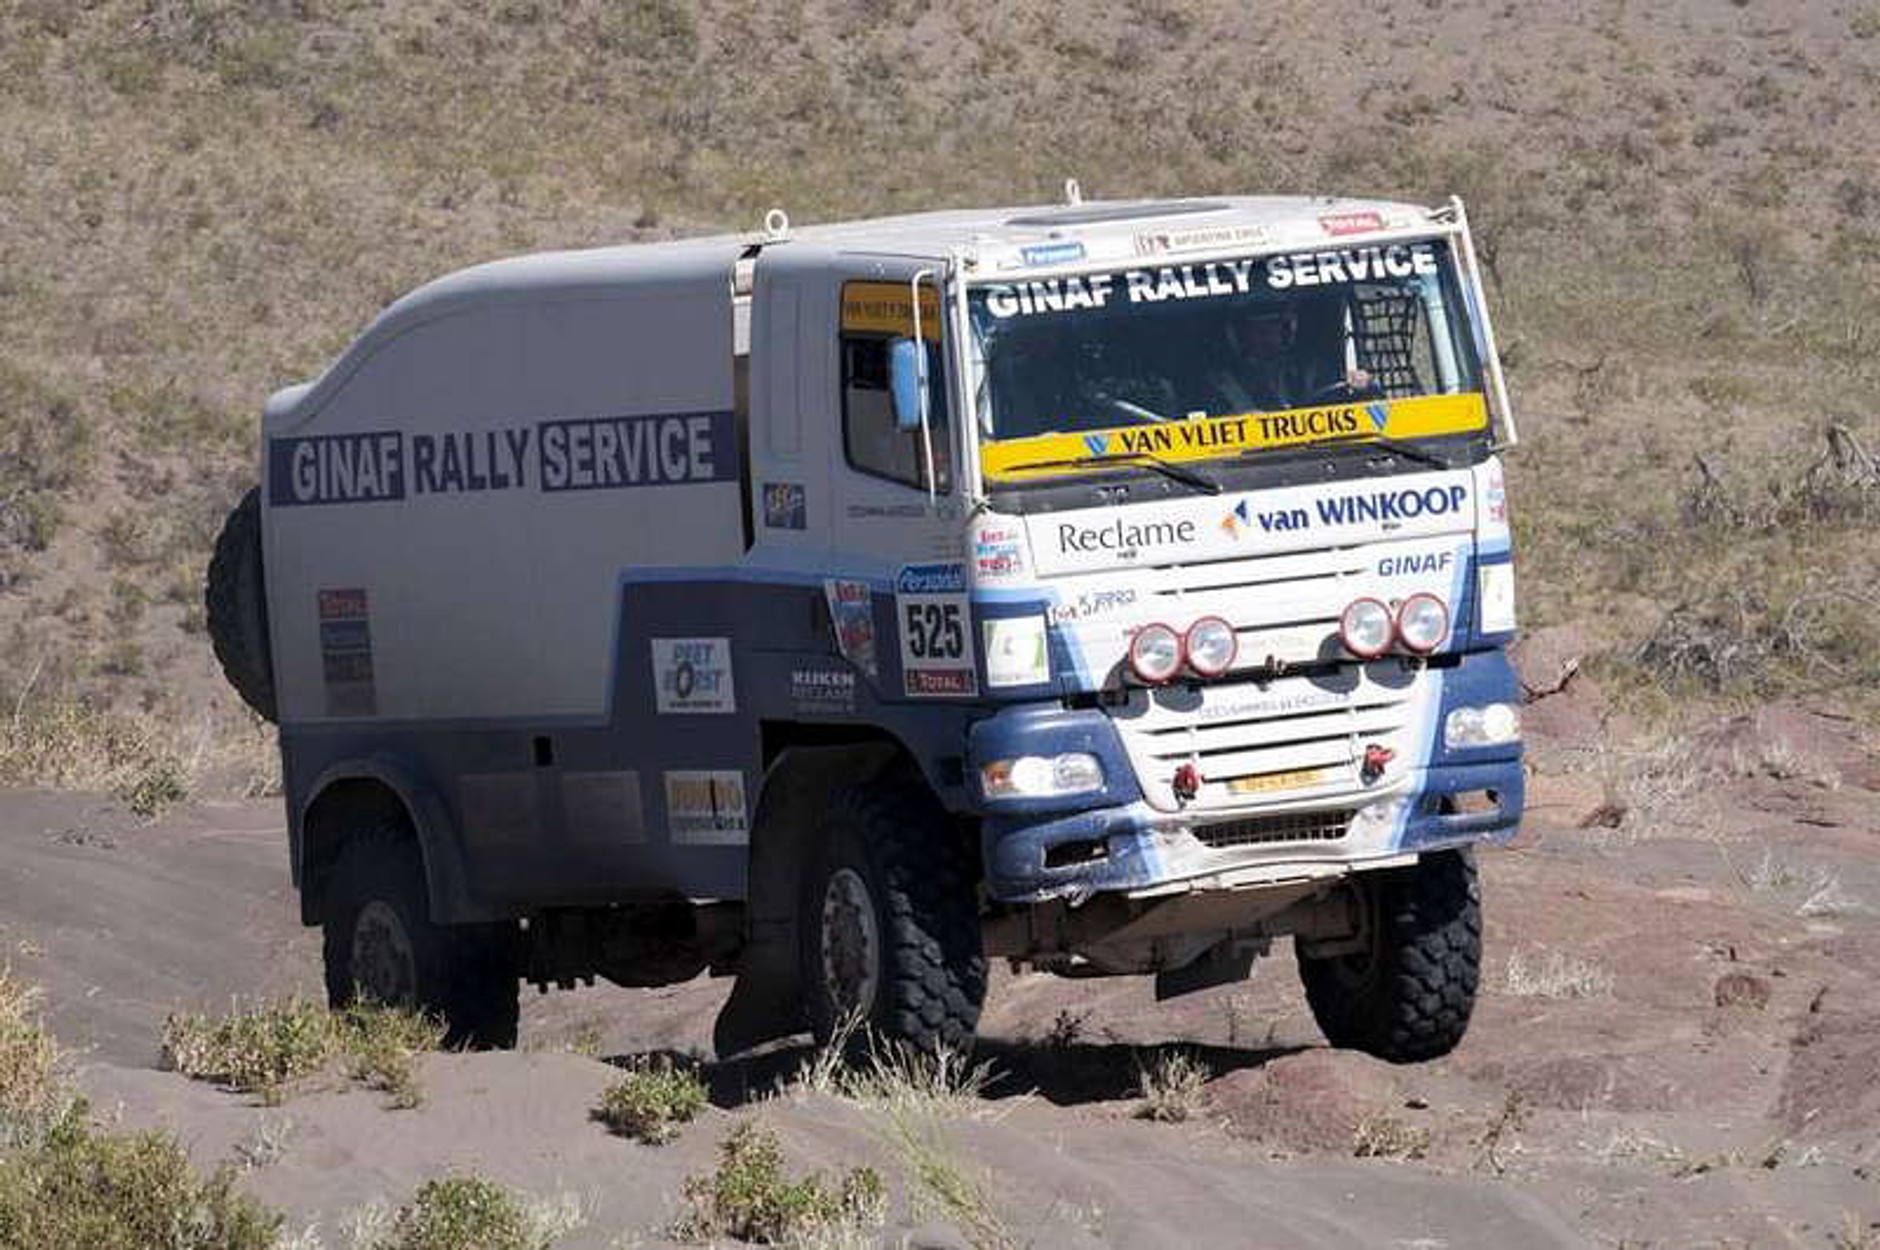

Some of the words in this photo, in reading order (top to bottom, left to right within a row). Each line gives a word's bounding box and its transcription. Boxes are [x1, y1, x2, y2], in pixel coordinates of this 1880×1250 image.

[988, 277, 1114, 318] GINAF
[1128, 259, 1253, 303] RALLY
[1267, 244, 1438, 288] SERVICE
[291, 437, 399, 502] GINAF
[414, 428, 531, 494] RALLY
[544, 415, 715, 489] SERVICE
[1121, 427, 1174, 453] VAN
[1180, 418, 1248, 448] VLIET
[1258, 409, 1358, 442] TRUCKS
[1059, 516, 1196, 553] Reclame
[1259, 505, 1310, 533] van
[1316, 484, 1467, 526] WINKOOP
[1378, 551, 1453, 577] GINAF
[906, 603, 964, 660] 525
